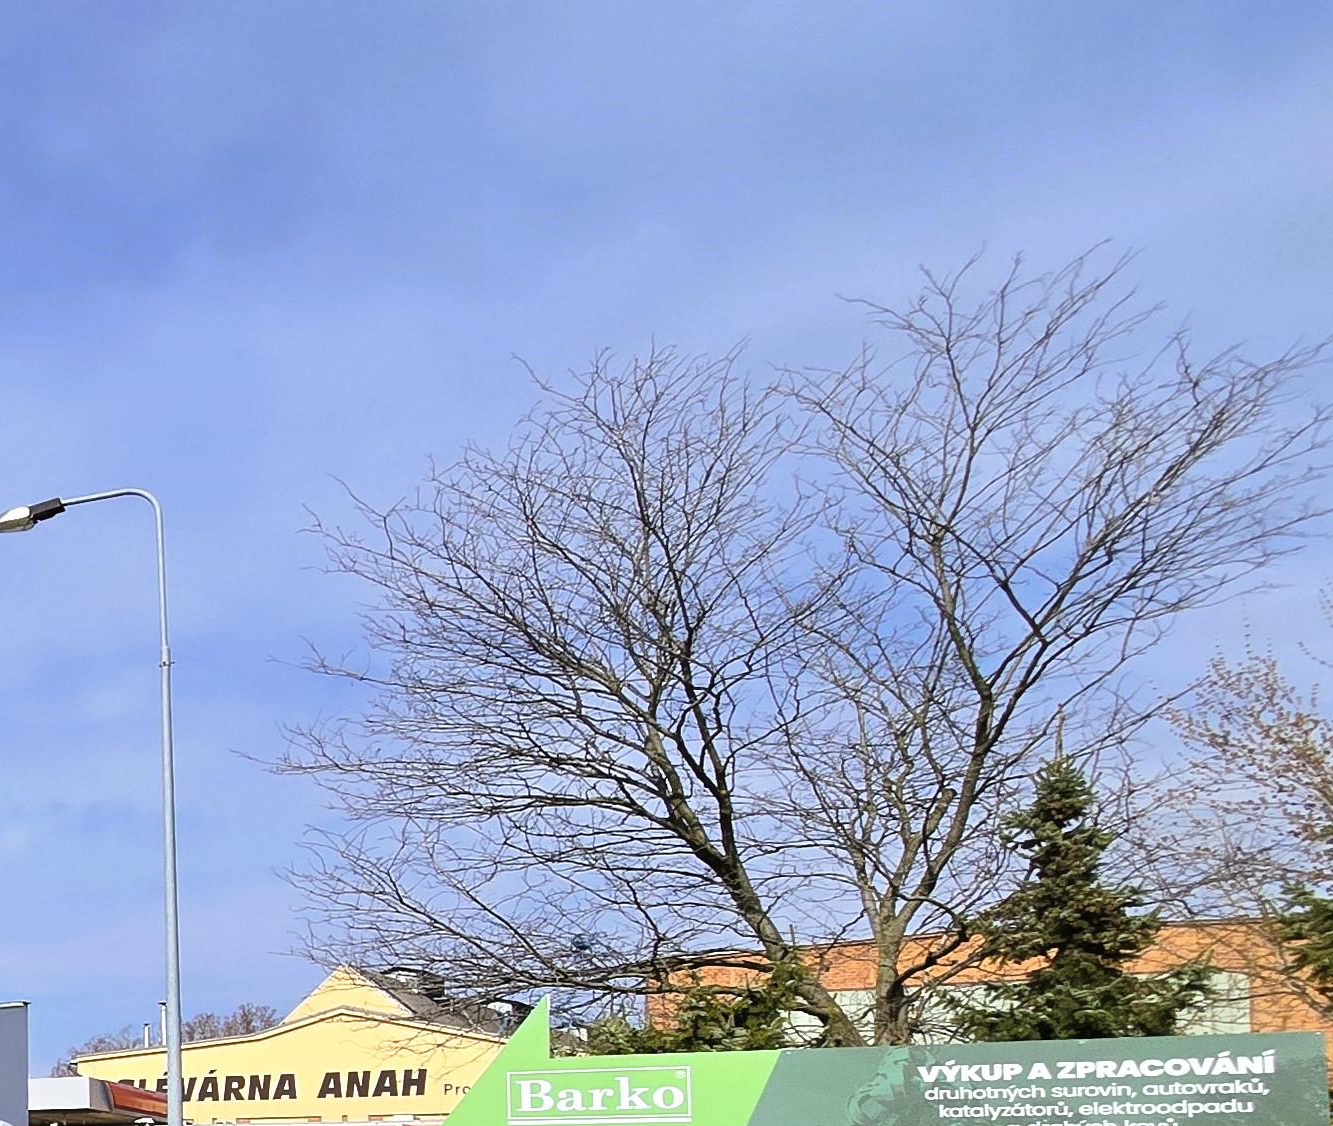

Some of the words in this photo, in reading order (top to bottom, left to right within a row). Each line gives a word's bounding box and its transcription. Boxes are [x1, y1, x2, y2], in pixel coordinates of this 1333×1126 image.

[917, 1060, 1024, 1083] VÝKUP
[1027, 1061, 1052, 1080] A
[1056, 1050, 1277, 1080] ZPRACOVÁNÍ
[317, 1068, 428, 1099] ANAH
[516, 1076, 685, 1112] Barko
[924, 1084, 1046, 1103] druhotných
[1050, 1082, 1137, 1099] surovin,
[1142, 1079, 1270, 1097] autovraků,
[938, 1101, 1074, 1120] katalyzátorů,
[1078, 1099, 1254, 1118] elektroodpadu
